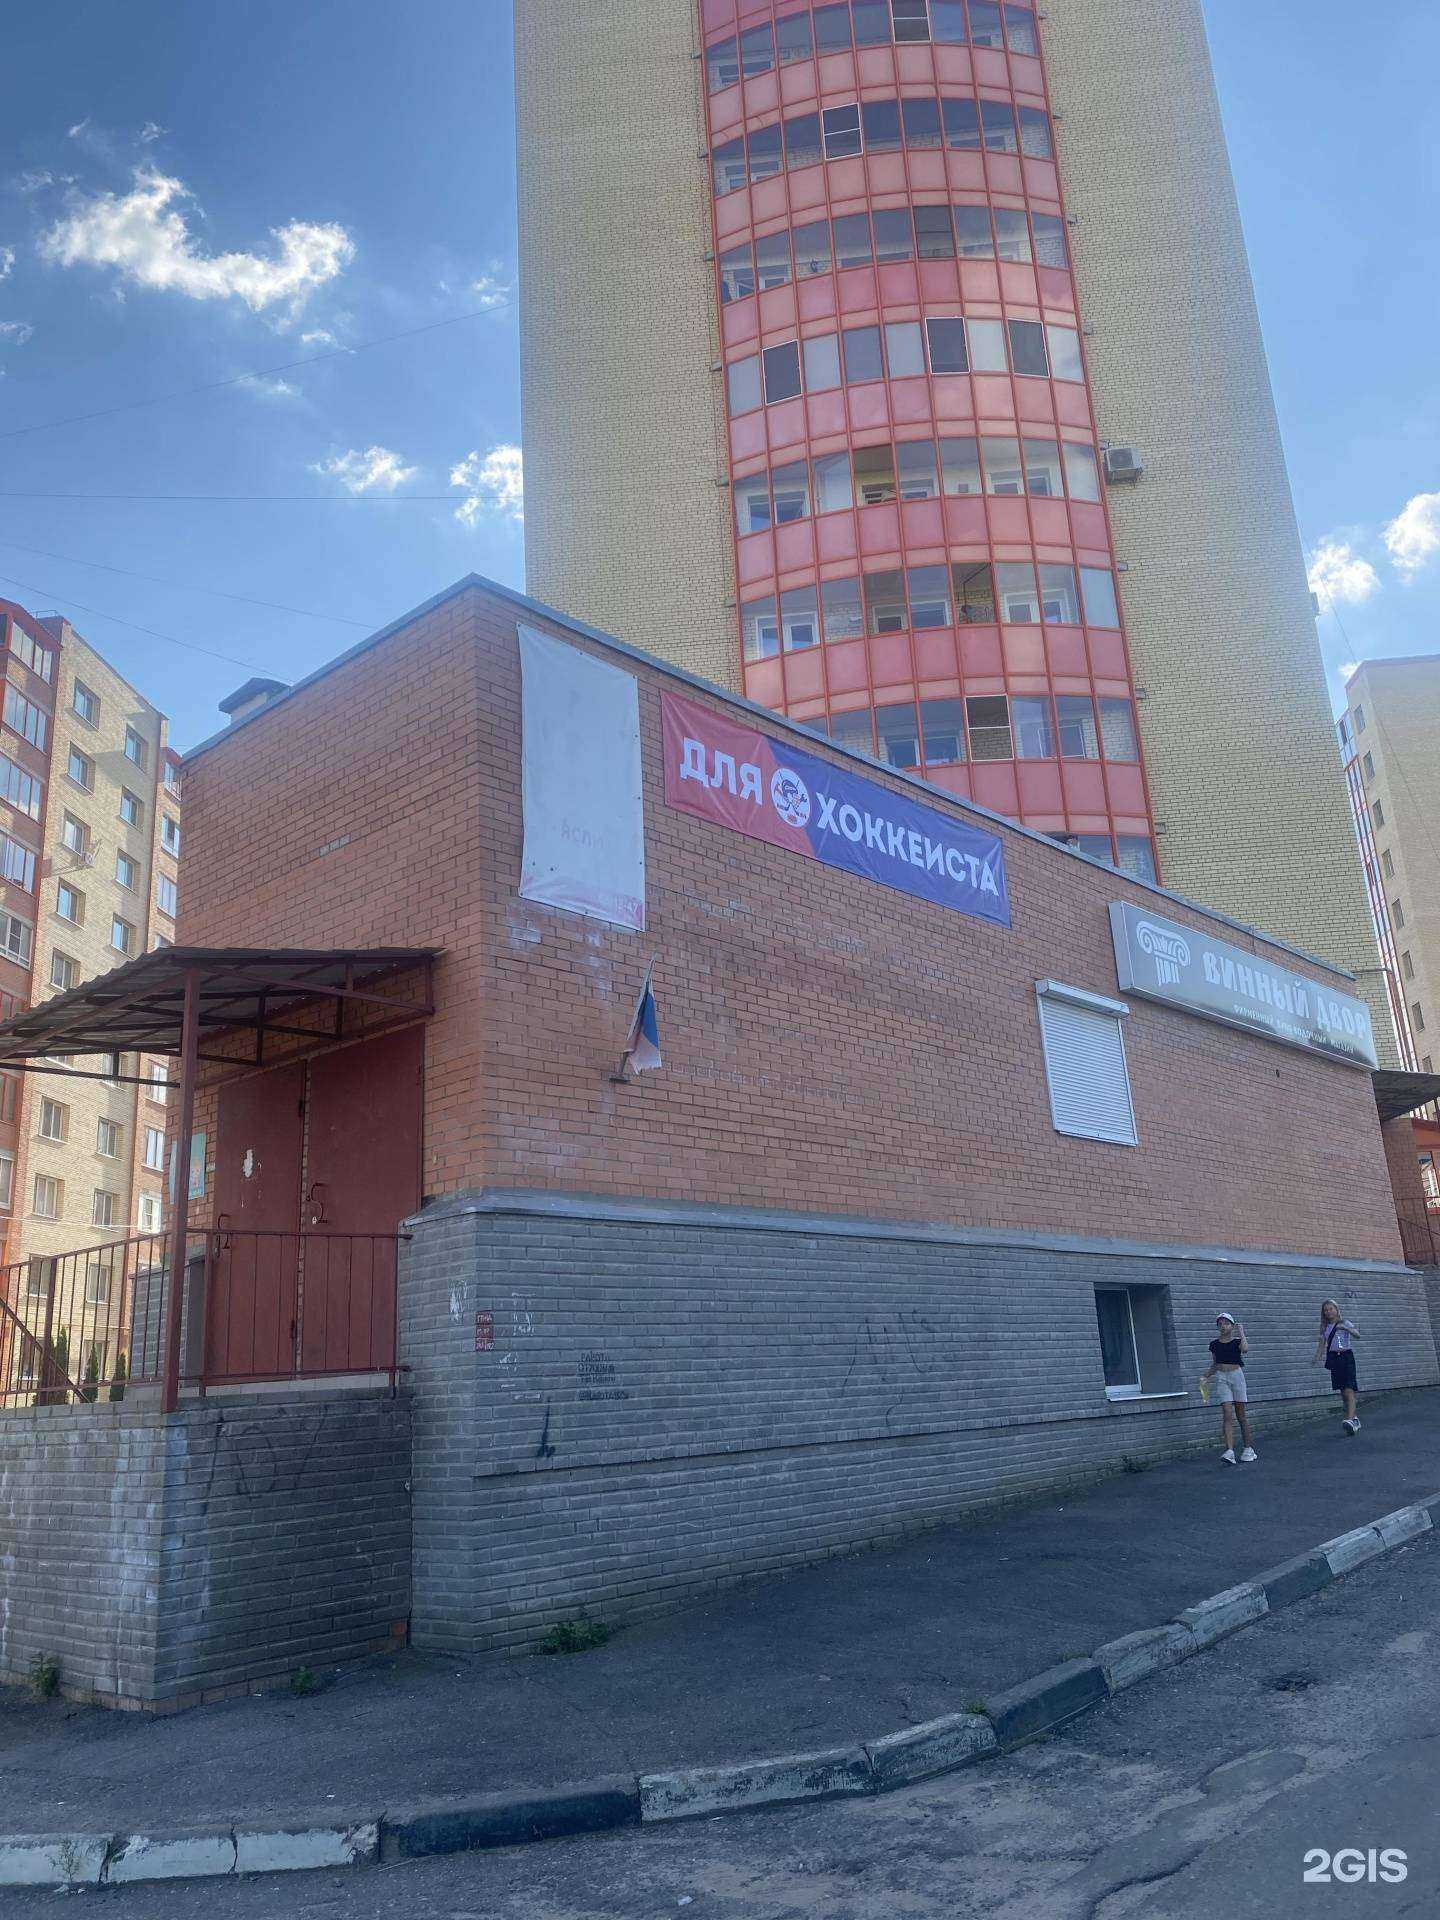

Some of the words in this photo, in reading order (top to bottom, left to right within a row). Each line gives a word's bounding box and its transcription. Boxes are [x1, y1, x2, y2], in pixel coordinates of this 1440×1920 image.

[680, 736, 763, 806] ДЛЯ
[816, 792, 999, 896] ХОККЕИСТА
[1203, 952, 1310, 1018] ВИННЫЙ
[1317, 995, 1367, 1039] ДВОР
